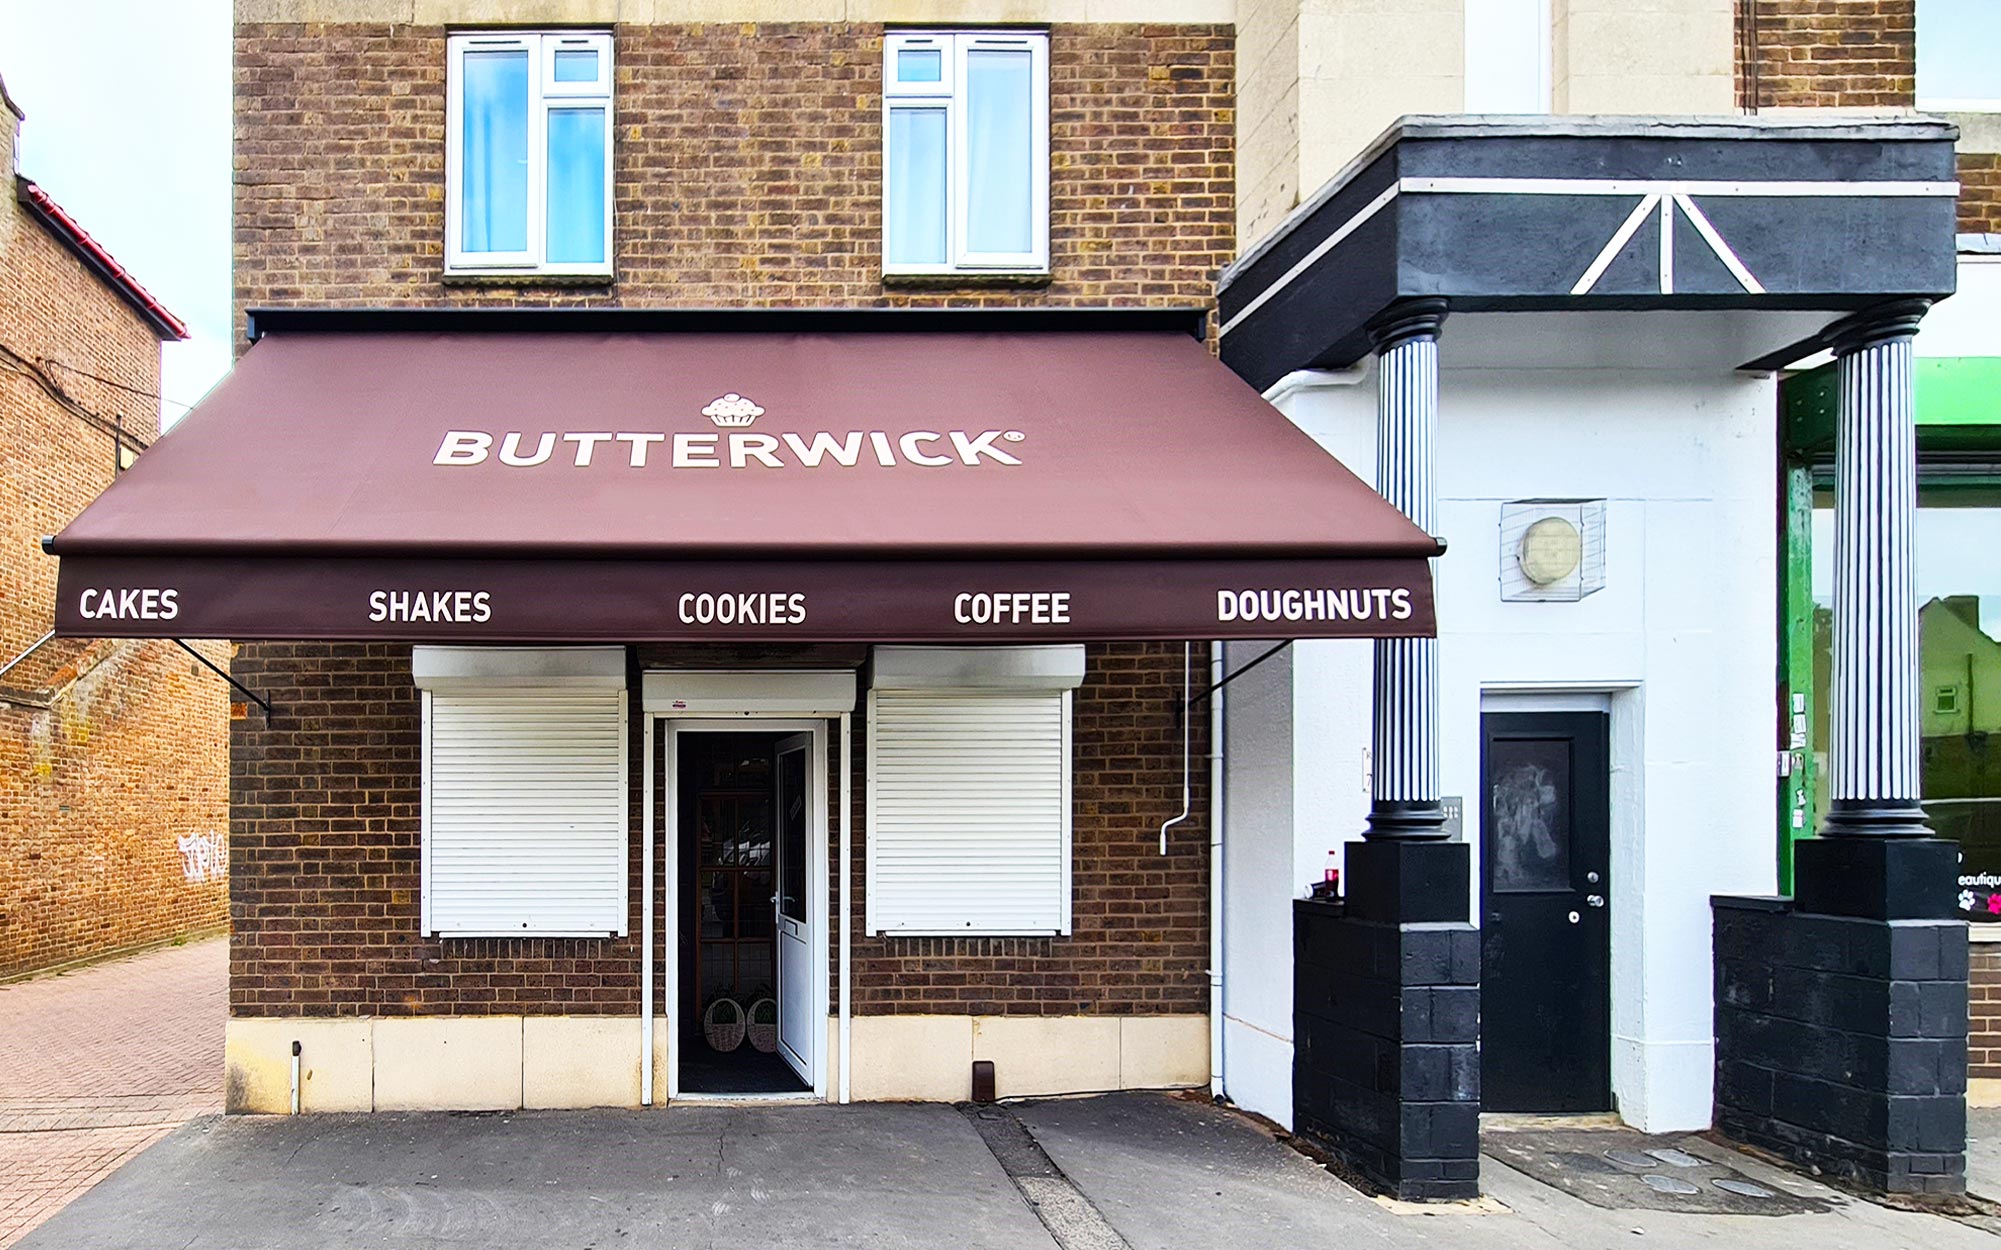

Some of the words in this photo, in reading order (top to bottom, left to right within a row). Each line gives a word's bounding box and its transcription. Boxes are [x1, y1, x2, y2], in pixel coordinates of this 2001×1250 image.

[432, 430, 1023, 467] BUTTERWICK
[79, 588, 179, 620] CAKES
[368, 590, 491, 623] SHAKES
[678, 592, 806, 625] COOKIES
[954, 592, 1071, 624] COFFEE
[1217, 588, 1412, 621] DOUGHNUTS
